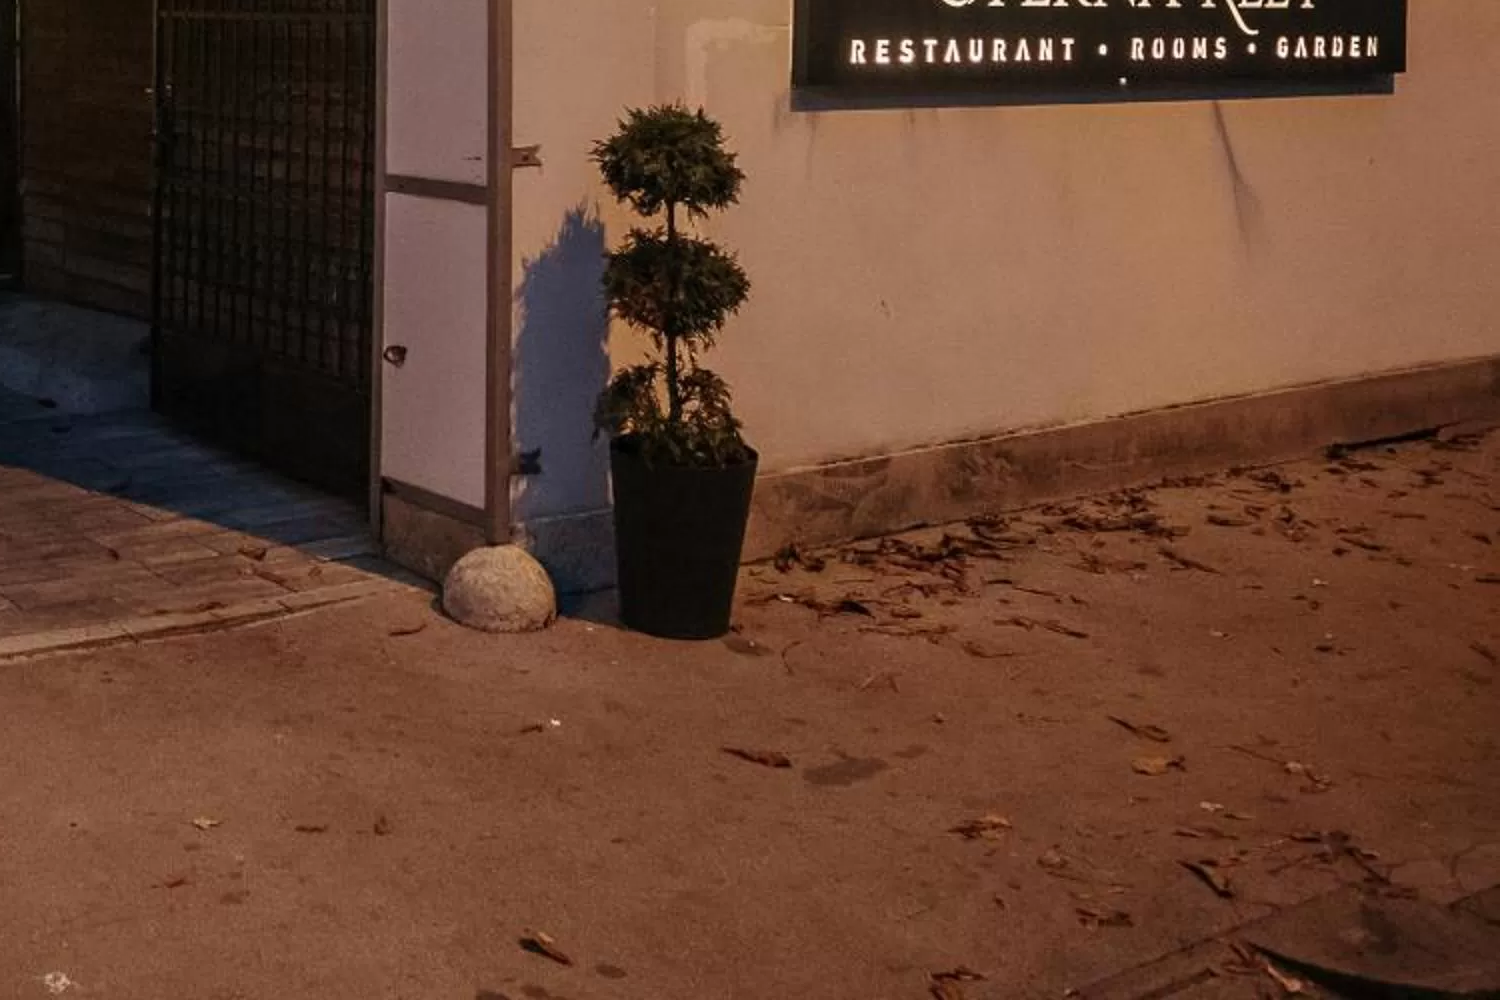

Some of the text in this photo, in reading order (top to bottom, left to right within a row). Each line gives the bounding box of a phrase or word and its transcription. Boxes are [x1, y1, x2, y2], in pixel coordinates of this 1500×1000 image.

[849, 35, 1380, 66] RESTAURANT ROOMS GARDEN
